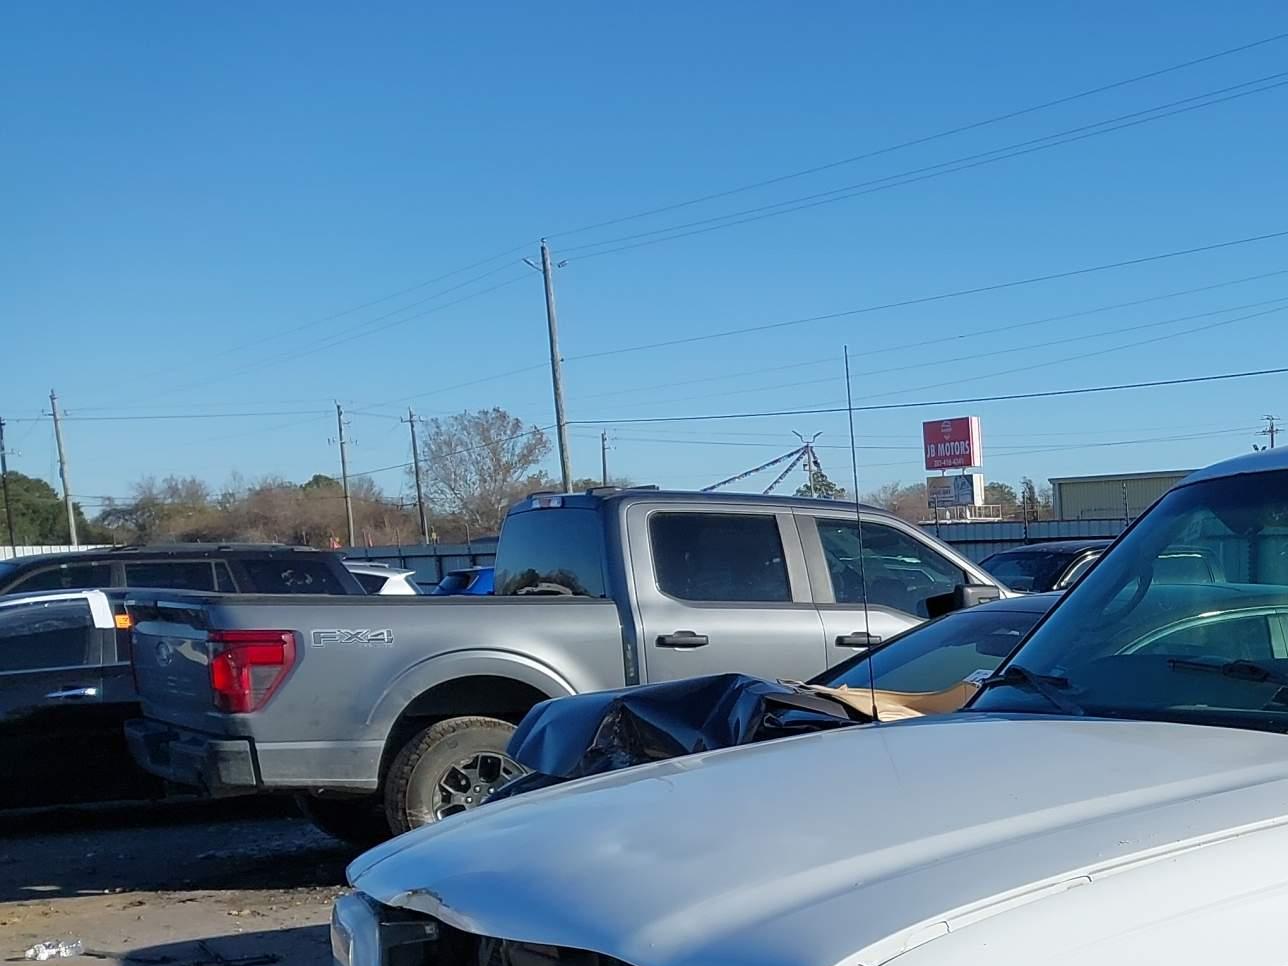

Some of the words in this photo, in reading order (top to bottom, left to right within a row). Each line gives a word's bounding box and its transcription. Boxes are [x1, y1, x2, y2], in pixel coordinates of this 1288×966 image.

[927, 444, 936, 458] JB
[938, 441, 970, 457] MOTORS
[311, 629, 394, 648] FX4
